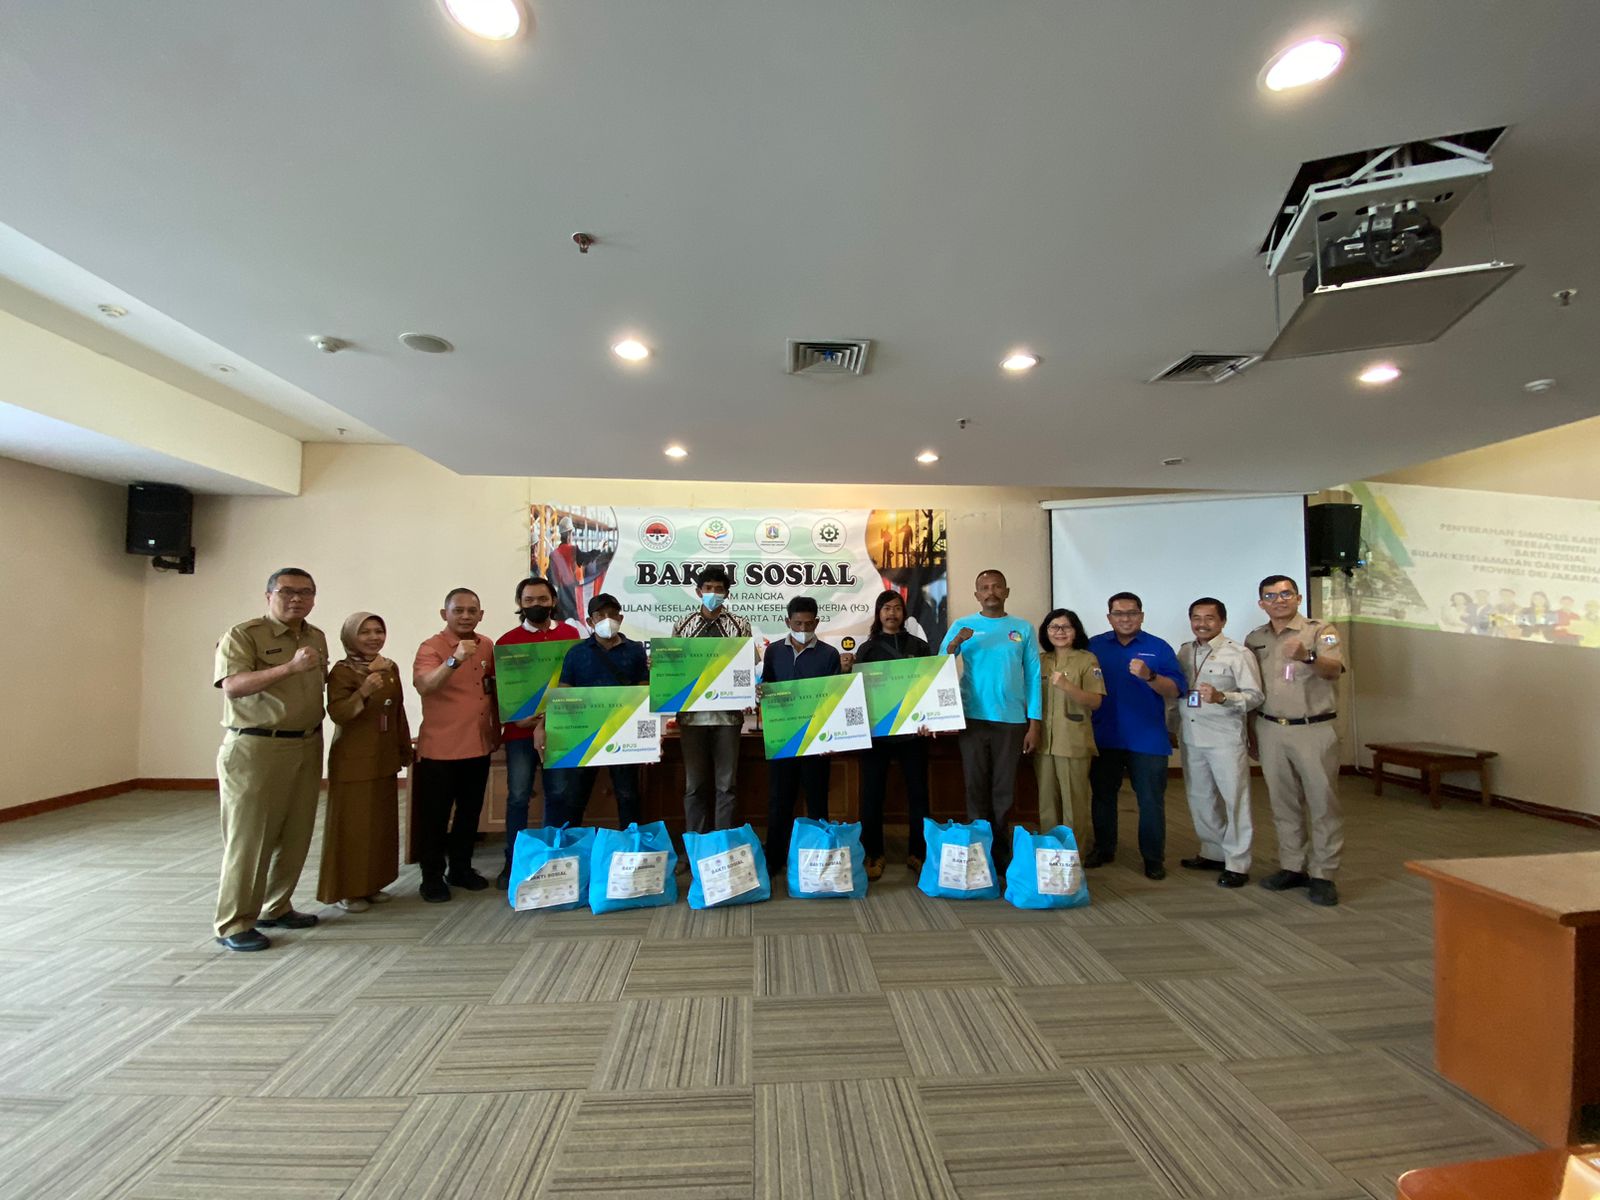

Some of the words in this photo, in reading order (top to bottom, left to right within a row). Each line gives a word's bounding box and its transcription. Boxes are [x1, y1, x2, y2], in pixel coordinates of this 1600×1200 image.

[745, 562, 857, 586] SOSIAL
[741, 592, 784, 600] RANGKA
[621, 604, 652, 612] ULAN
[732, 604, 755, 612] DAN
[820, 603, 848, 612] KERJA
[850, 603, 870, 613] (K3)
